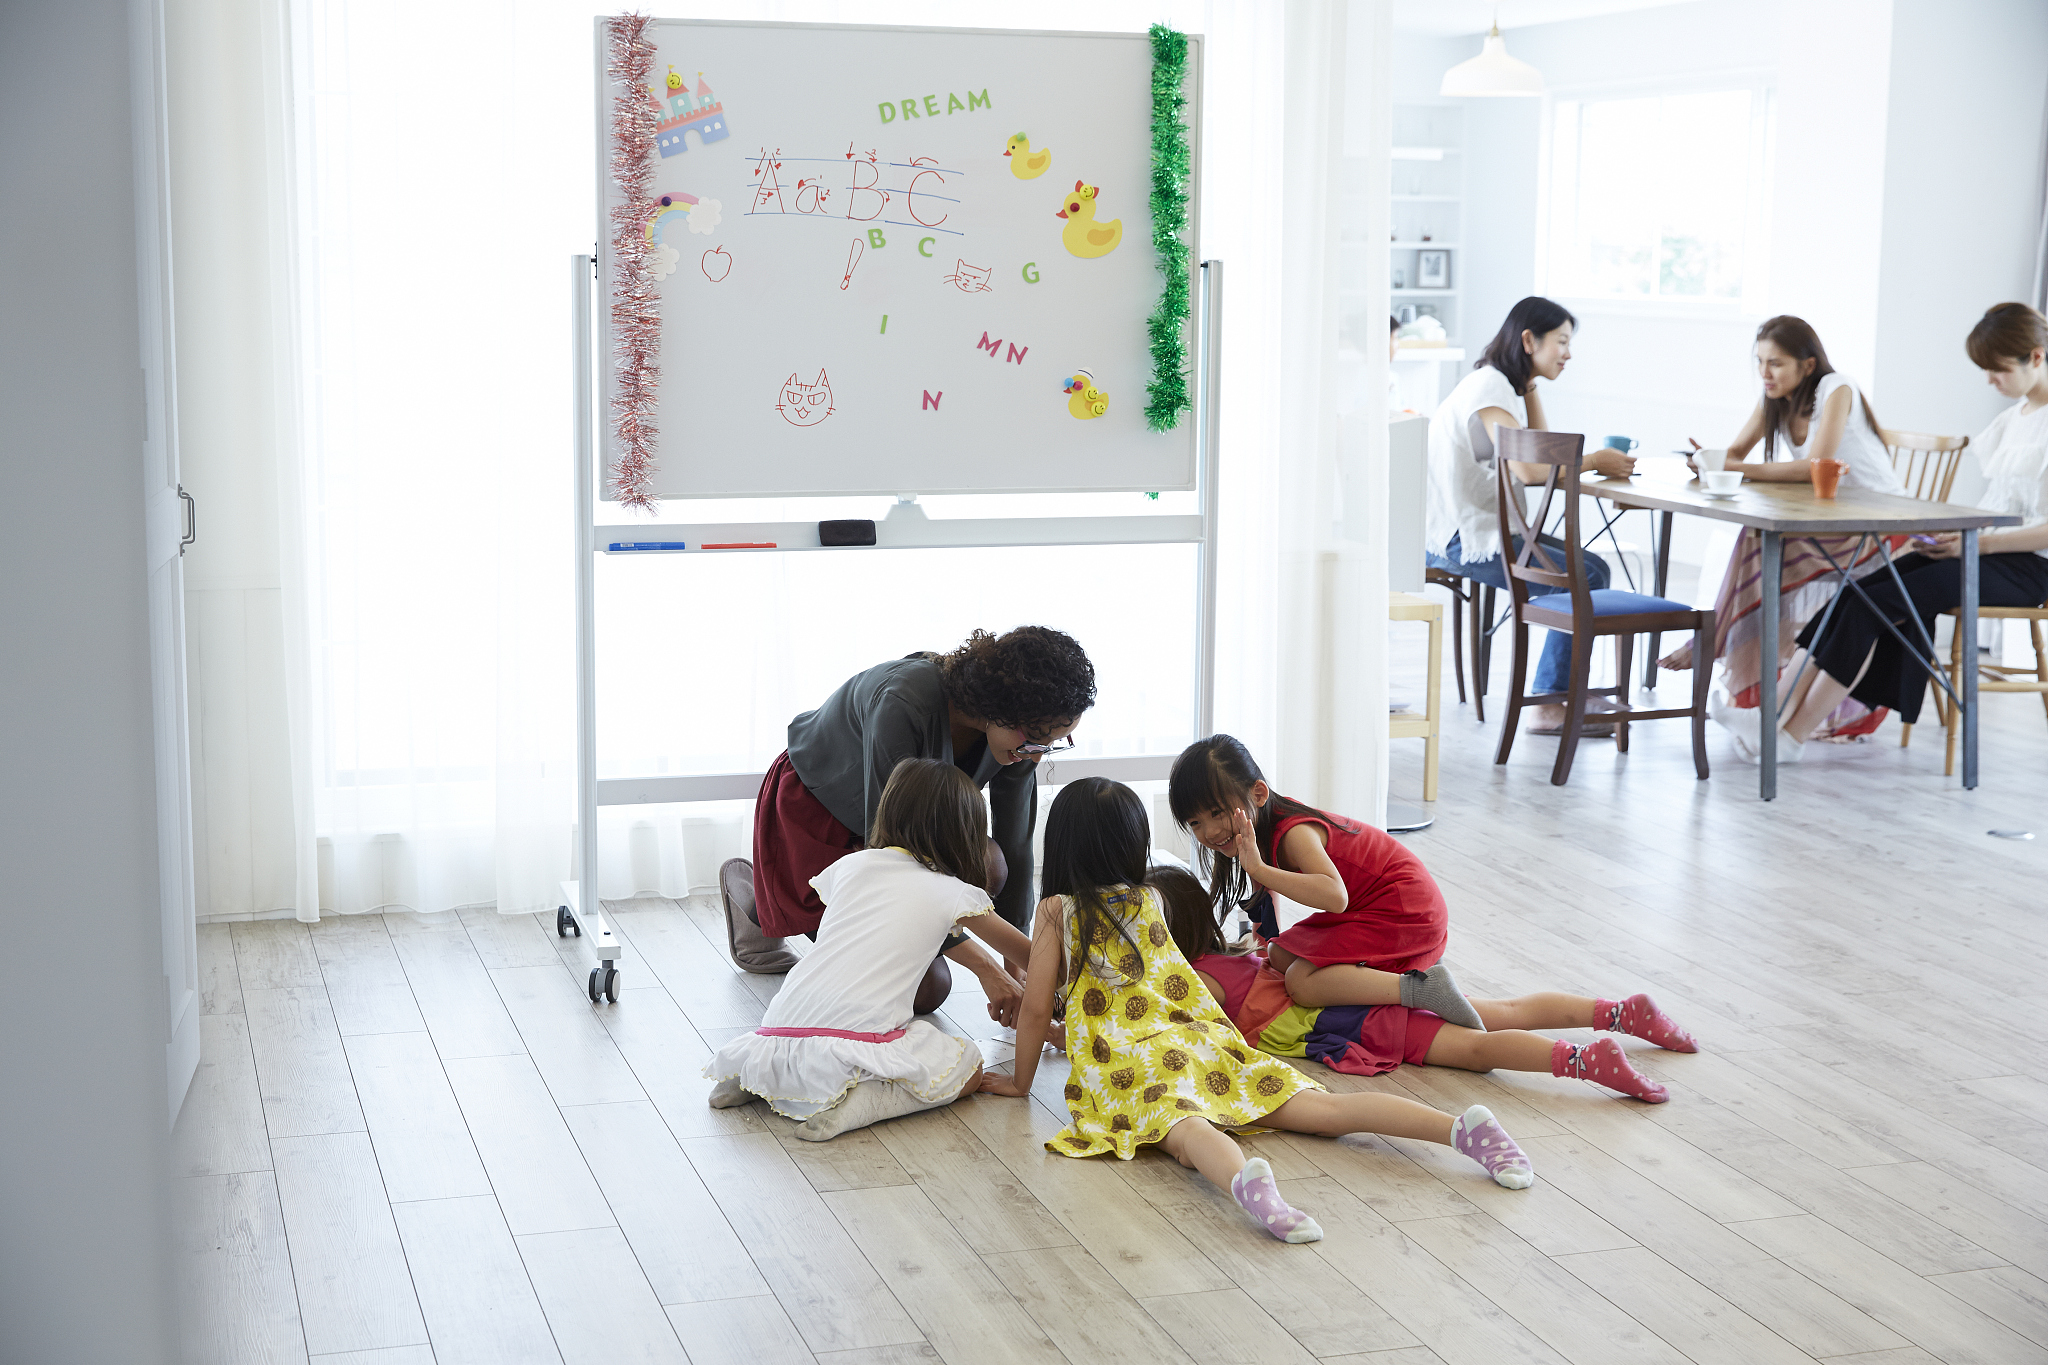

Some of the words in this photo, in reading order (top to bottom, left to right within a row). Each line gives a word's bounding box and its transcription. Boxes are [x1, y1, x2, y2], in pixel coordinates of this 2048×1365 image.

[878, 88, 992, 124] DREAM
[846, 159, 885, 222] B
[907, 170, 948, 227] C
[867, 228, 887, 249] B
[918, 236, 936, 258] C
[1021, 261, 1041, 285] G
[880, 314, 889, 335] I
[922, 389, 943, 412] N
